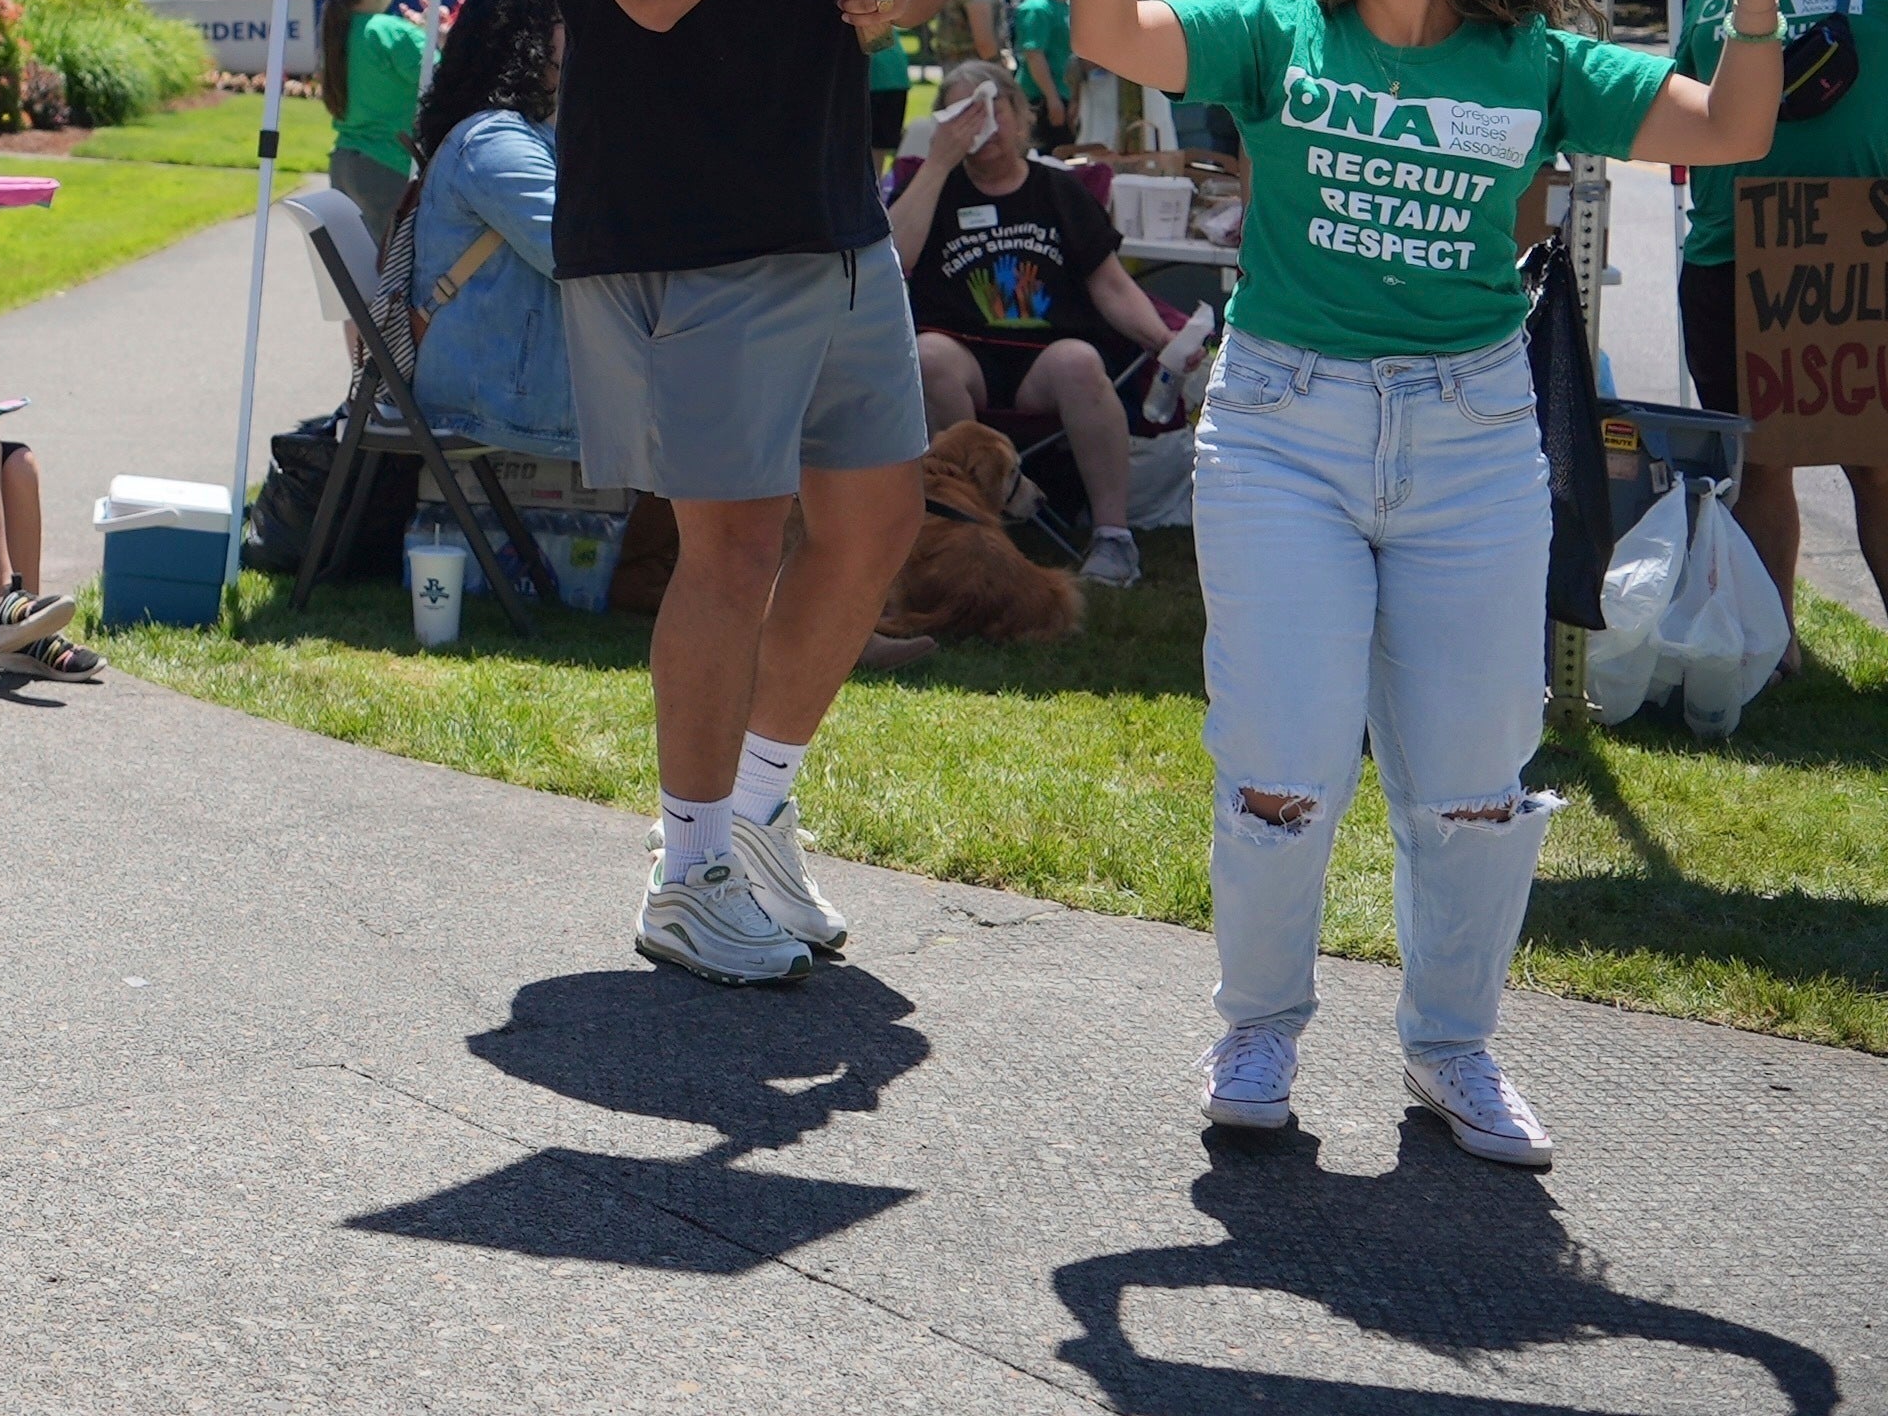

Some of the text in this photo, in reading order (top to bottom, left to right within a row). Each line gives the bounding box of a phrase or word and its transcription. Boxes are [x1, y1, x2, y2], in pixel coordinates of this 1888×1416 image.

[1288, 77, 1440, 148] ONA
[1450, 104, 1510, 126] Oregon
[1450, 121, 1507, 142] Nurses
[1307, 145, 1496, 204] RECRUIT
[1449, 136, 1525, 164] Association
[1320, 187, 1472, 233] RETAIN
[1740, 181, 1828, 249] THE
[941, 246, 983, 279] Raise
[1308, 216, 1476, 270] RESPECT
[1747, 262, 1888, 332] WOUL
